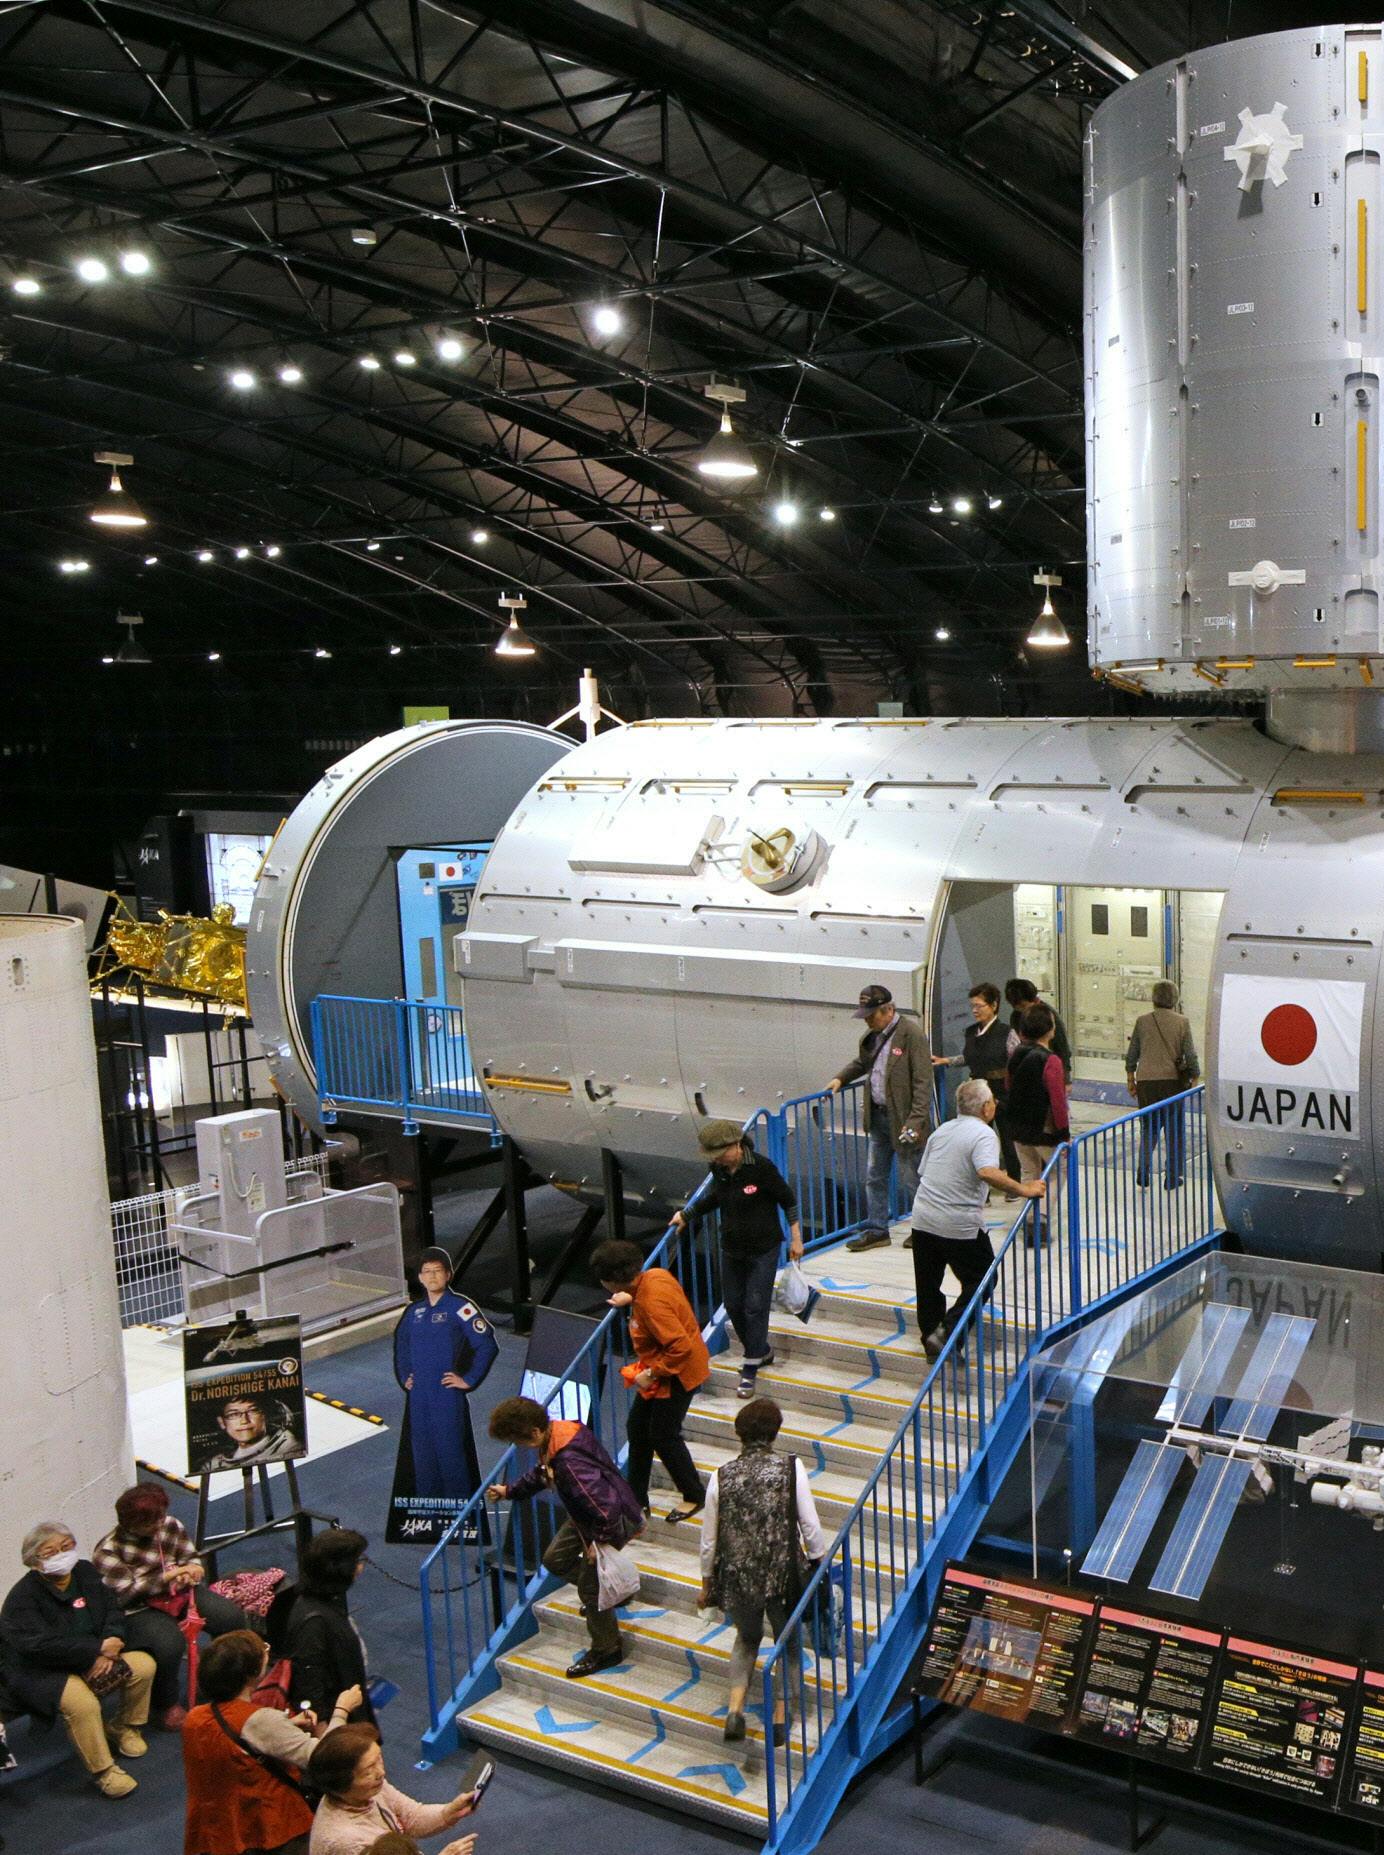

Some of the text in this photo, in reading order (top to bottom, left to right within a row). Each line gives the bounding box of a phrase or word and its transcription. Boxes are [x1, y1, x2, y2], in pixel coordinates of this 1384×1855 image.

[1226, 1085, 1352, 1132] JAPAN
[207, 1372, 251, 1387] EXPEDITION
[253, 1369, 278, 1381] 54/55
[268, 1377, 299, 1391] KANAI
[395, 1497, 484, 1510] ISS EXPEDITION 545
[400, 1518, 432, 1537] JAXA
